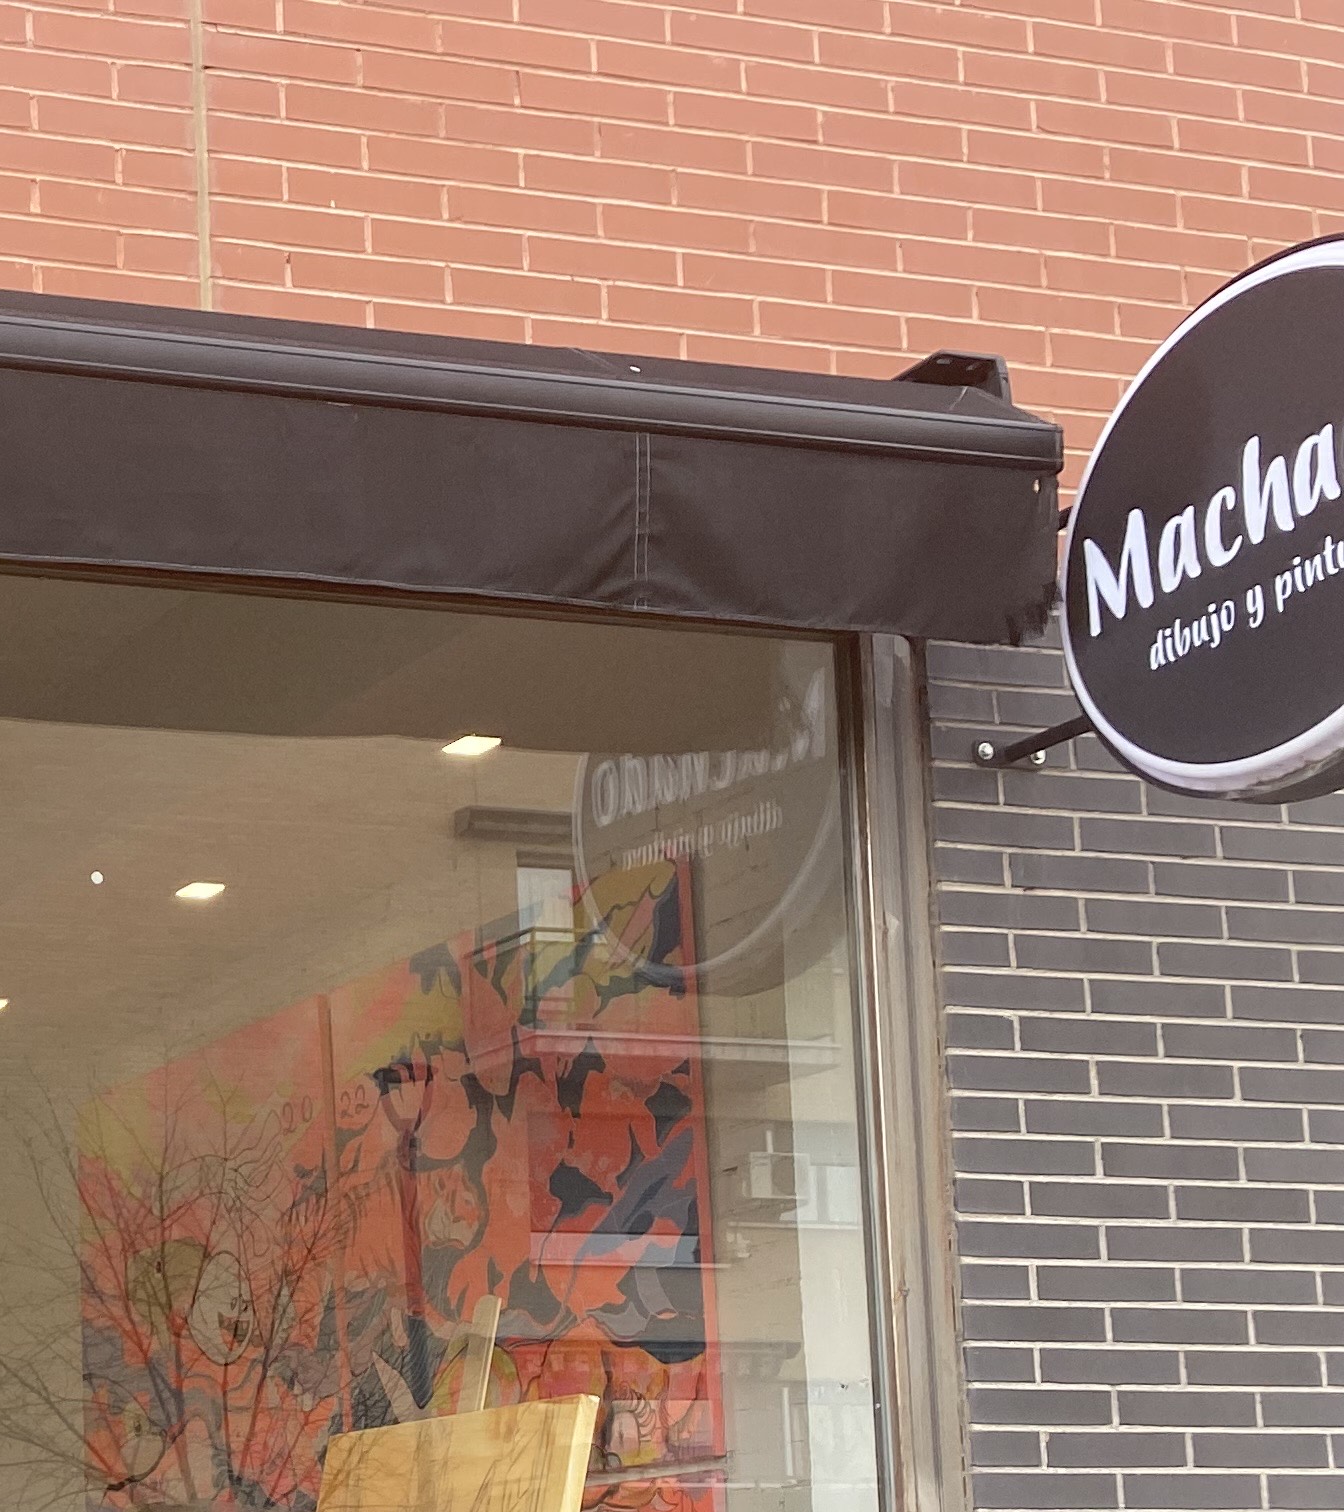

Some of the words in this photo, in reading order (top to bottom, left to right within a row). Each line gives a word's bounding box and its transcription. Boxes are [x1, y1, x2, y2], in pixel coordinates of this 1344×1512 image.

[1083, 422, 1342, 637] Macha
[1150, 599, 1235, 671] dibujo
[1246, 584, 1265, 629] y
